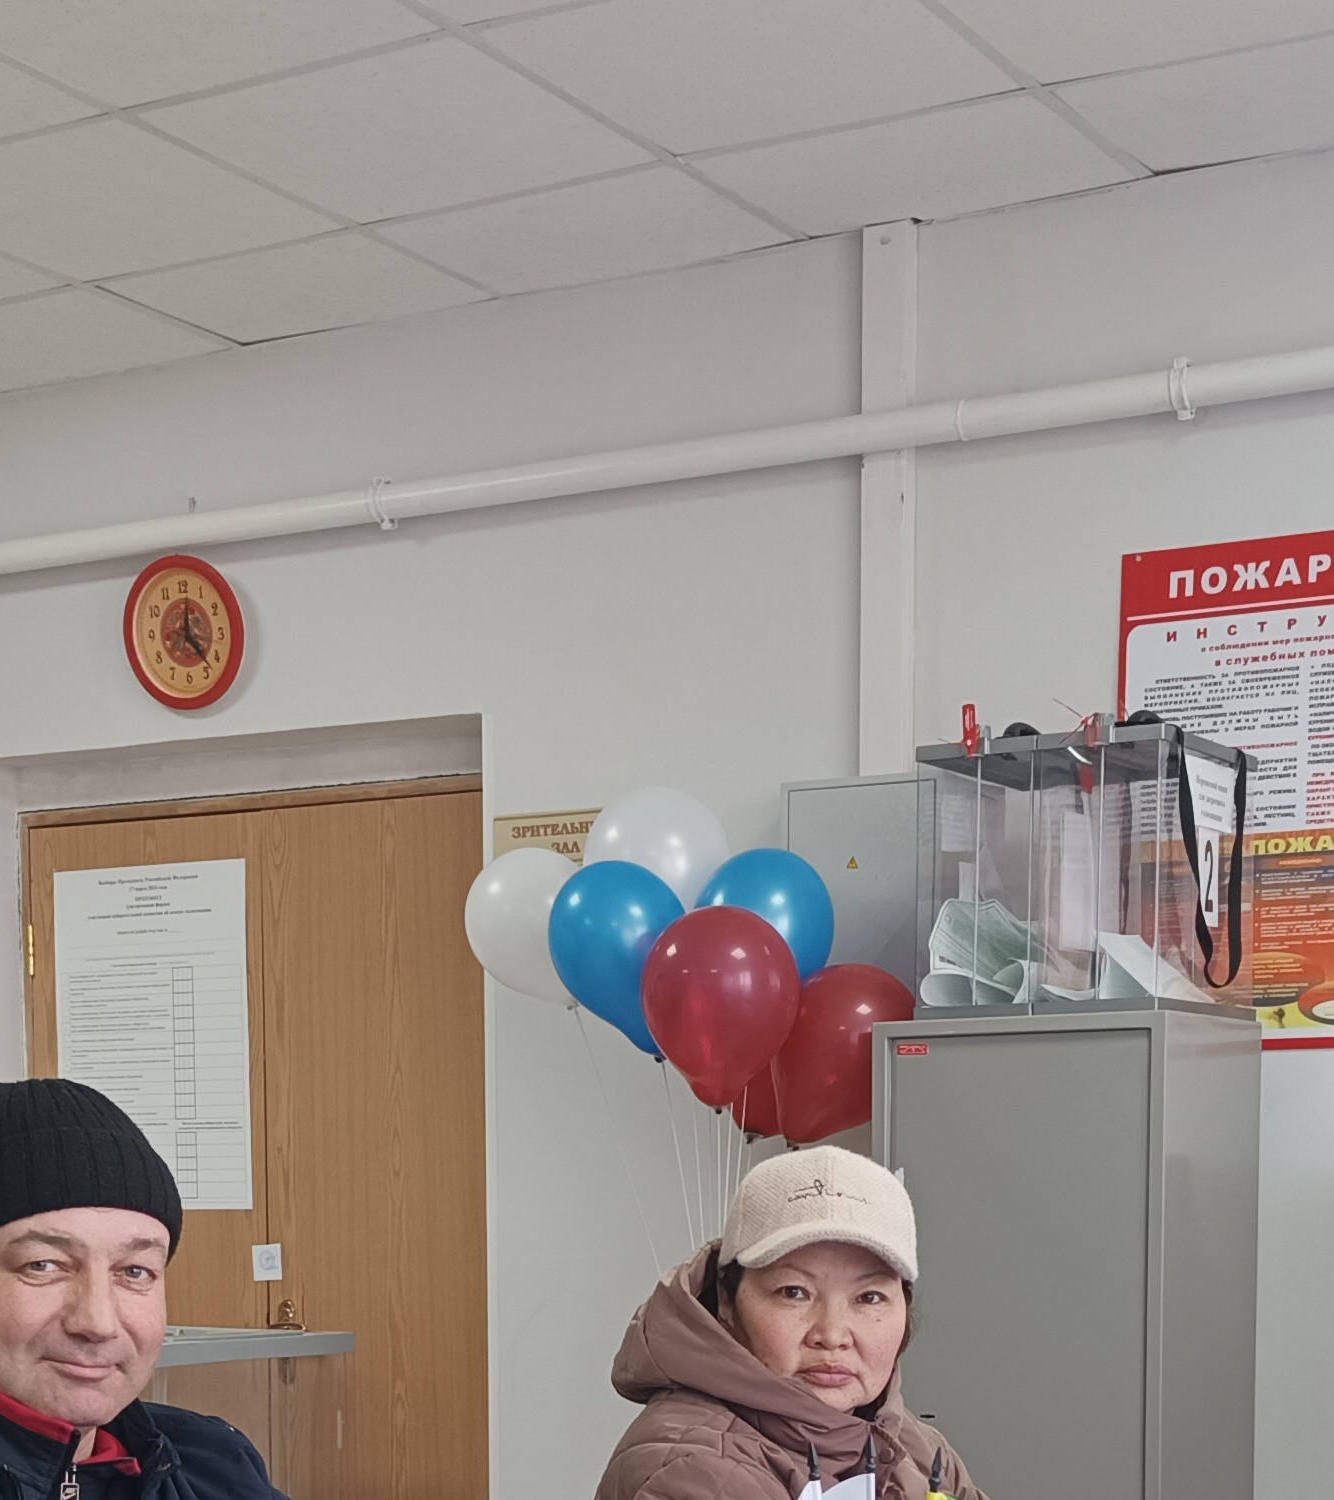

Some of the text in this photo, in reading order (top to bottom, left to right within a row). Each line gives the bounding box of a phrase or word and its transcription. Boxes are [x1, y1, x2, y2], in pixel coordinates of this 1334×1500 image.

[161, 587, 170, 600] 11
[177, 580, 188, 594] 12
[199, 585, 204, 599] 1
[149, 605, 161, 618] 10
[211, 602, 219, 616] 2
[148, 629, 155, 642] 9
[217, 627, 225, 641] 3
[155, 650, 163, 664] 8
[1215, 659, 1221, 667] в
[1226, 649, 1306, 668] служебных
[169, 667, 176, 680] 7
[186, 671, 193, 685] 6
[203, 666, 210, 680] 5
[551, 841, 580, 854] ЗАЛ
[1205, 840, 1213, 912] 2
